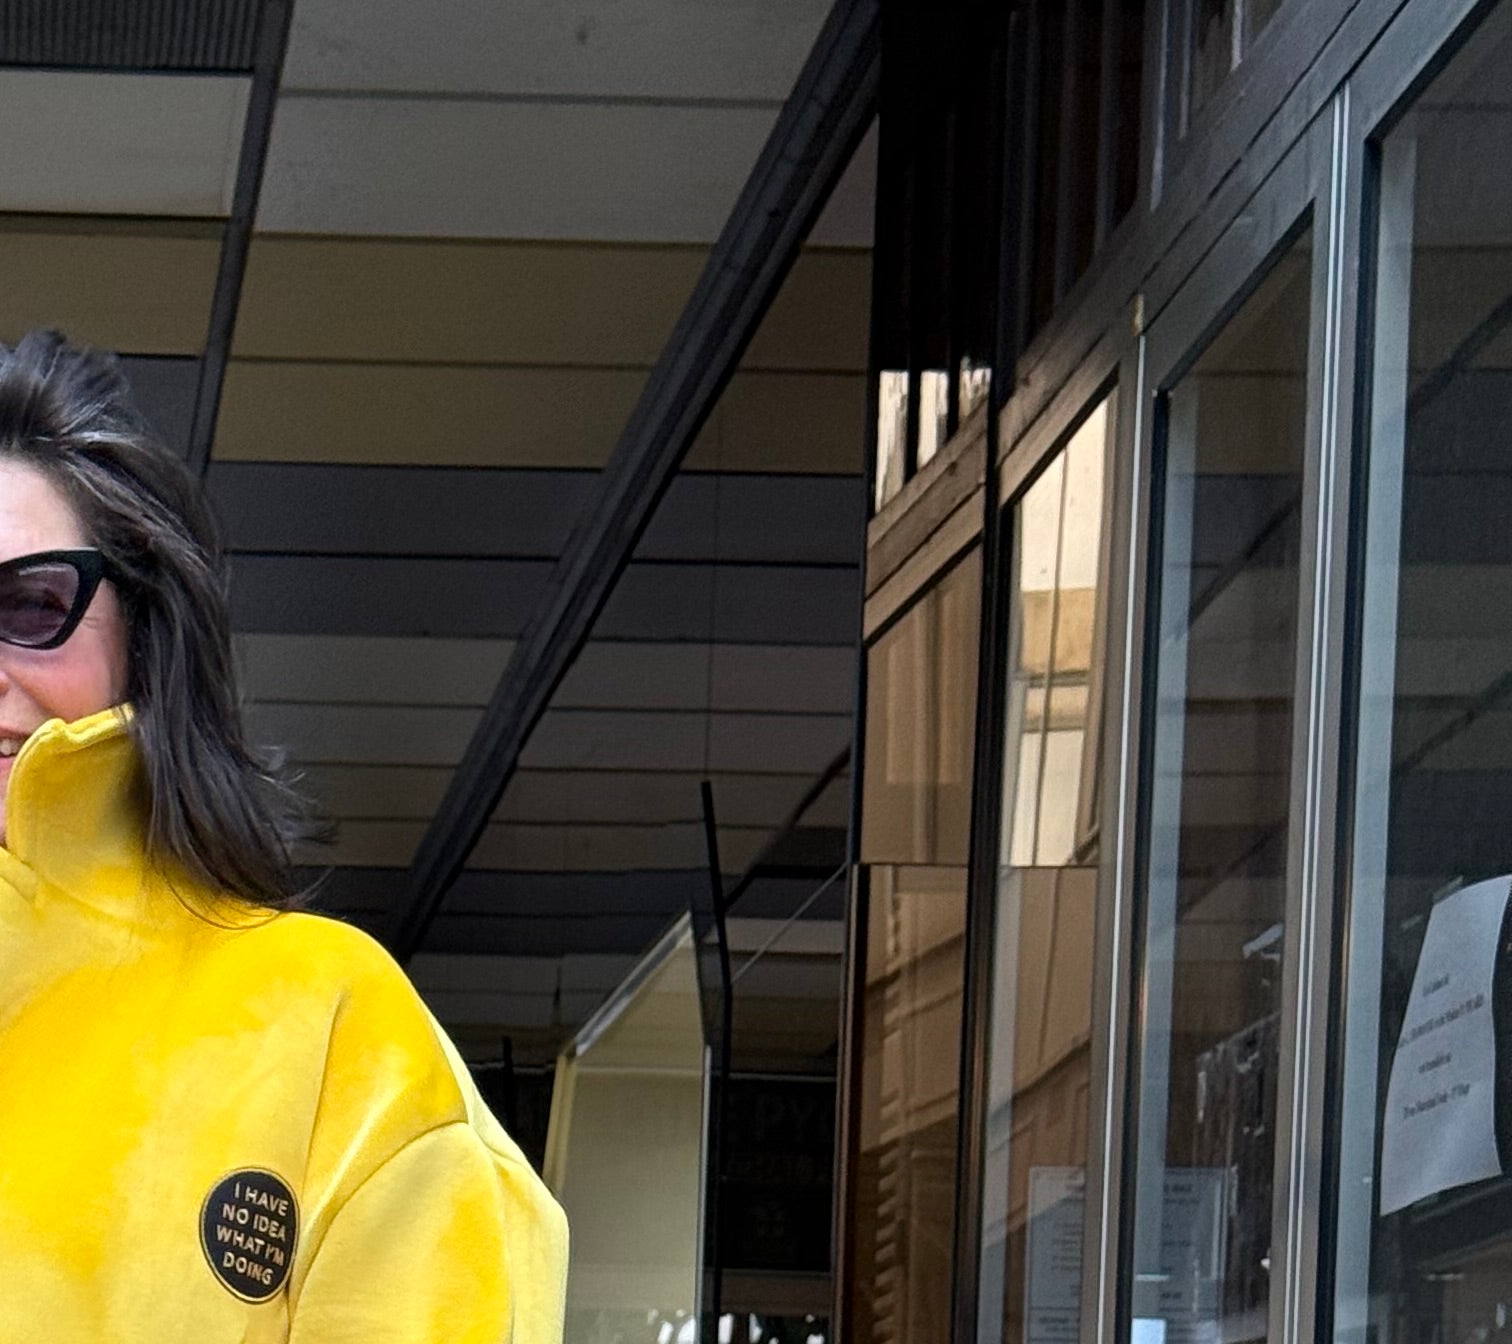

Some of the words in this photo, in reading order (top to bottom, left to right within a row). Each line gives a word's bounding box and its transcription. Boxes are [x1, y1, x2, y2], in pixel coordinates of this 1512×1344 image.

[234, 1181, 241, 1199] I
[244, 1186, 289, 1217] HAVE
[222, 1203, 250, 1225] NO
[253, 1214, 287, 1243] IDEA
[216, 1224, 265, 1255] WHAT
[264, 1243, 285, 1267] I'M
[222, 1251, 275, 1286] DOING
